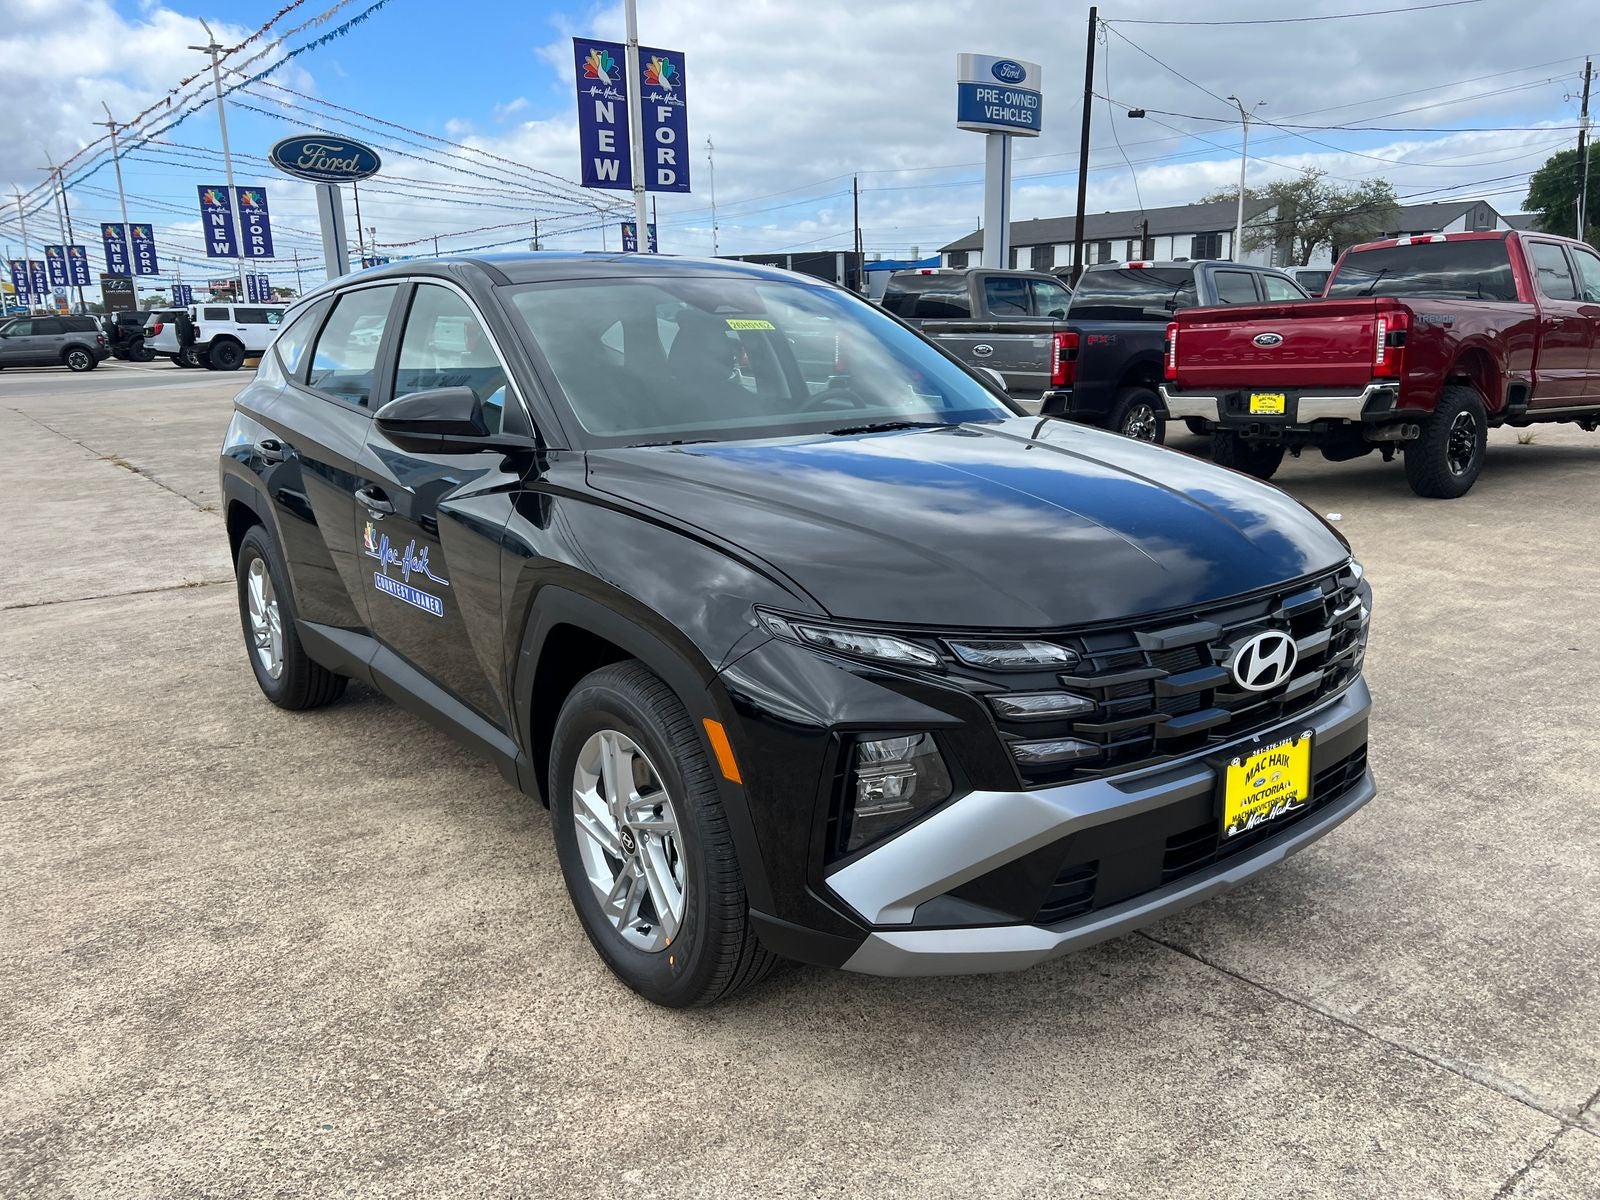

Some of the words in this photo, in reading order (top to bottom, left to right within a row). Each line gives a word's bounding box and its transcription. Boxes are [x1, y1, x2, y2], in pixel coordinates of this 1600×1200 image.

[1000, 63, 1021, 79] Ford
[586, 85, 603, 98] Mac
[646, 91, 663, 103] Mac
[976, 88, 1038, 109] PRE-OWNED
[984, 105, 1033, 124] VEHICLES
[594, 100, 620, 182] NEW
[655, 105, 676, 186] FORD
[297, 143, 360, 172] Ford
[211, 214, 230, 254] NEW
[250, 215, 265, 255] FORD
[52, 261, 64, 285] NEW
[75, 261, 86, 285] FORD
[111, 244, 125, 273] NEW
[139, 244, 152, 274] FORD
[1417, 314, 1457, 323] TREMOR
[1087, 334, 1117, 345] FX4
[372, 533, 402, 575] Mac
[402, 539, 441, 584] Haik
[376, 575, 410, 600] COURTESY
[411, 590, 441, 614] LOANER
[1245, 757, 1267, 786] MAC
[1268, 753, 1290, 768] HAIK
[1246, 781, 1285, 805] VICTORIA
[1243, 812, 1269, 831] Mac
[1269, 799, 1300, 820] Haik
